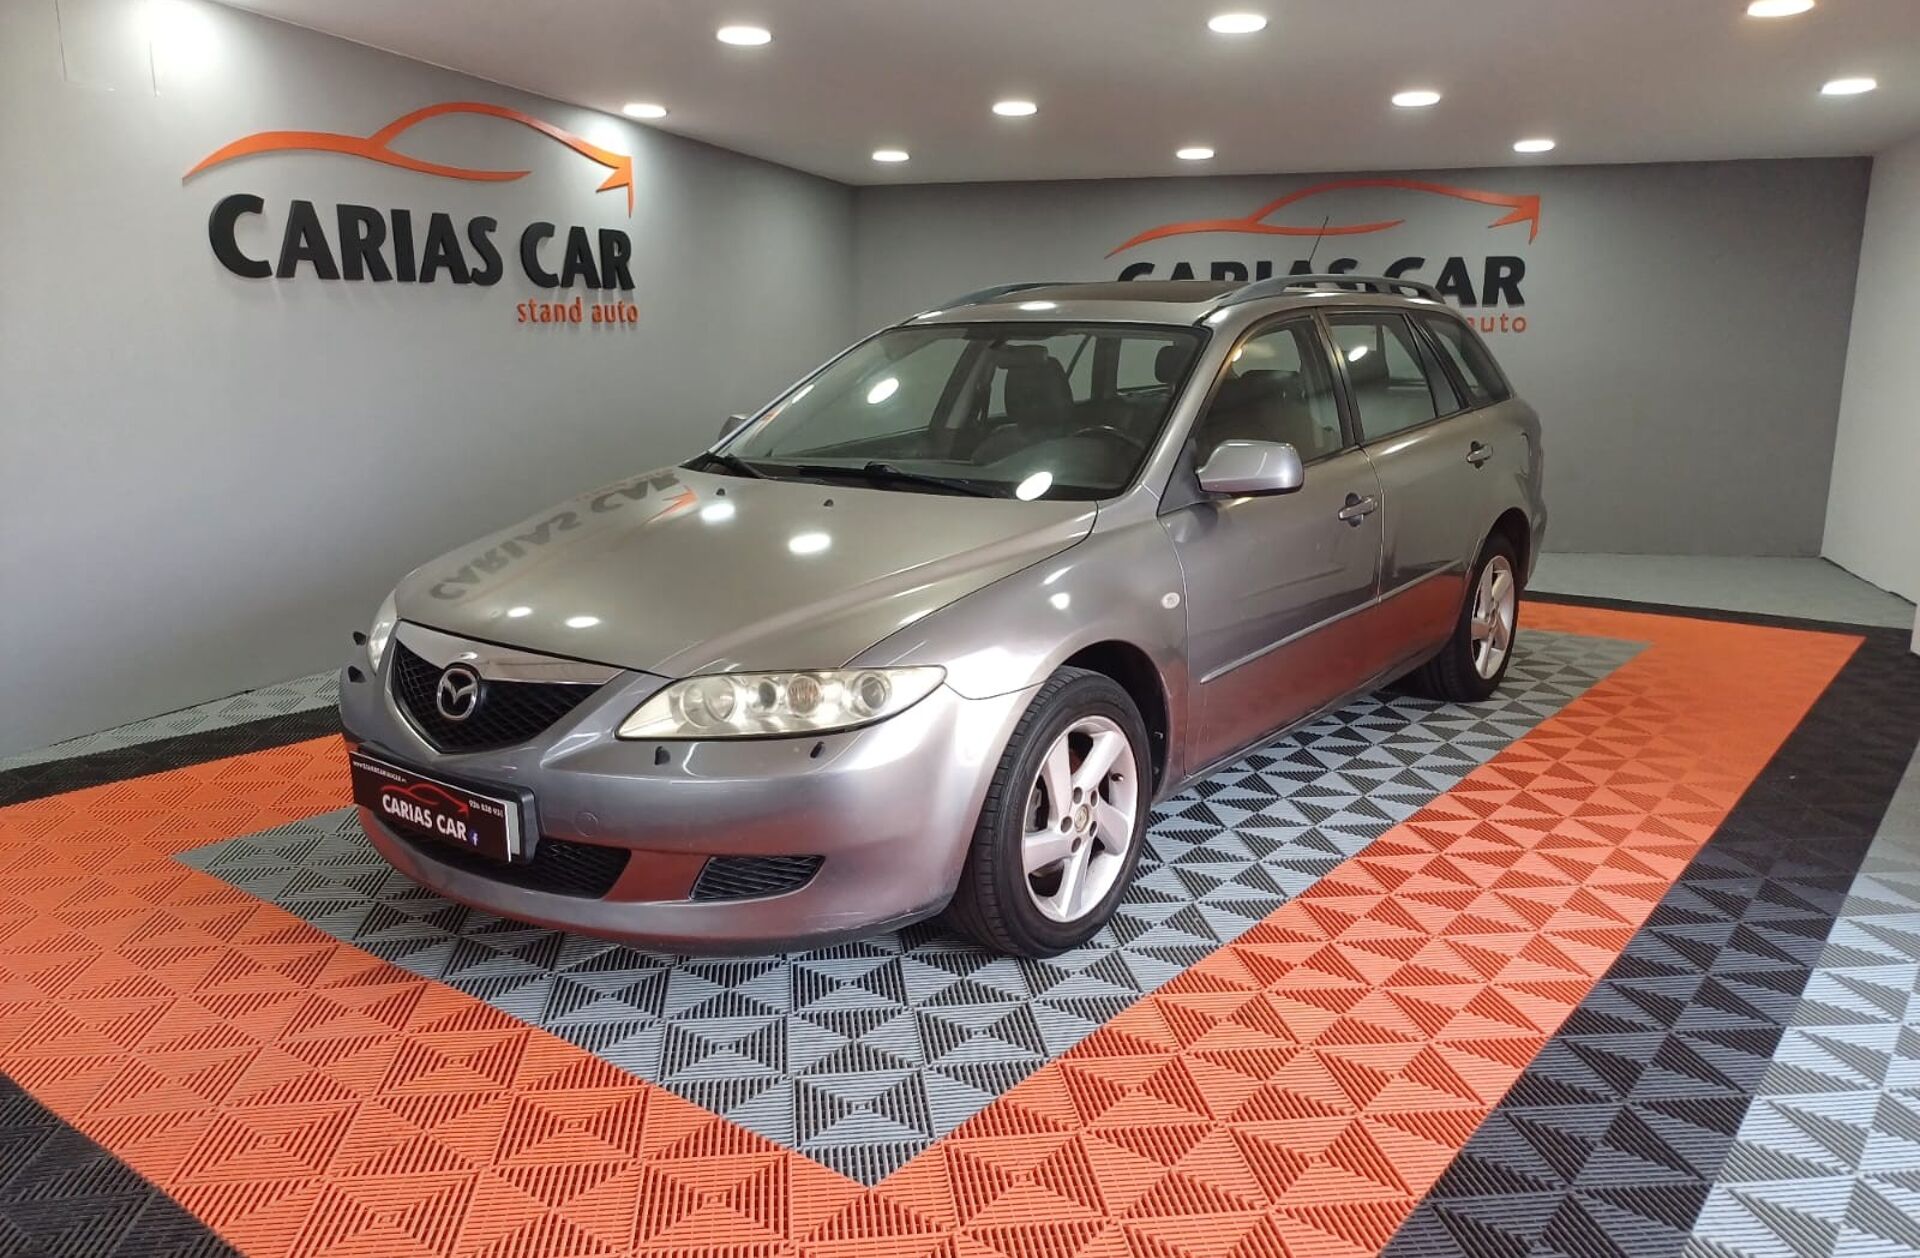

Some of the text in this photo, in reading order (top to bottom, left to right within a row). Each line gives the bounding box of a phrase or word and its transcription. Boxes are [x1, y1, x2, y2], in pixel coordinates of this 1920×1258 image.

[208, 193, 636, 290] CARIAS CAR
[1384, 254, 1526, 307] CAR
[517, 297, 639, 324] stand auto
[382, 794, 433, 828] CARIAS
[436, 814, 468, 841] CAR
